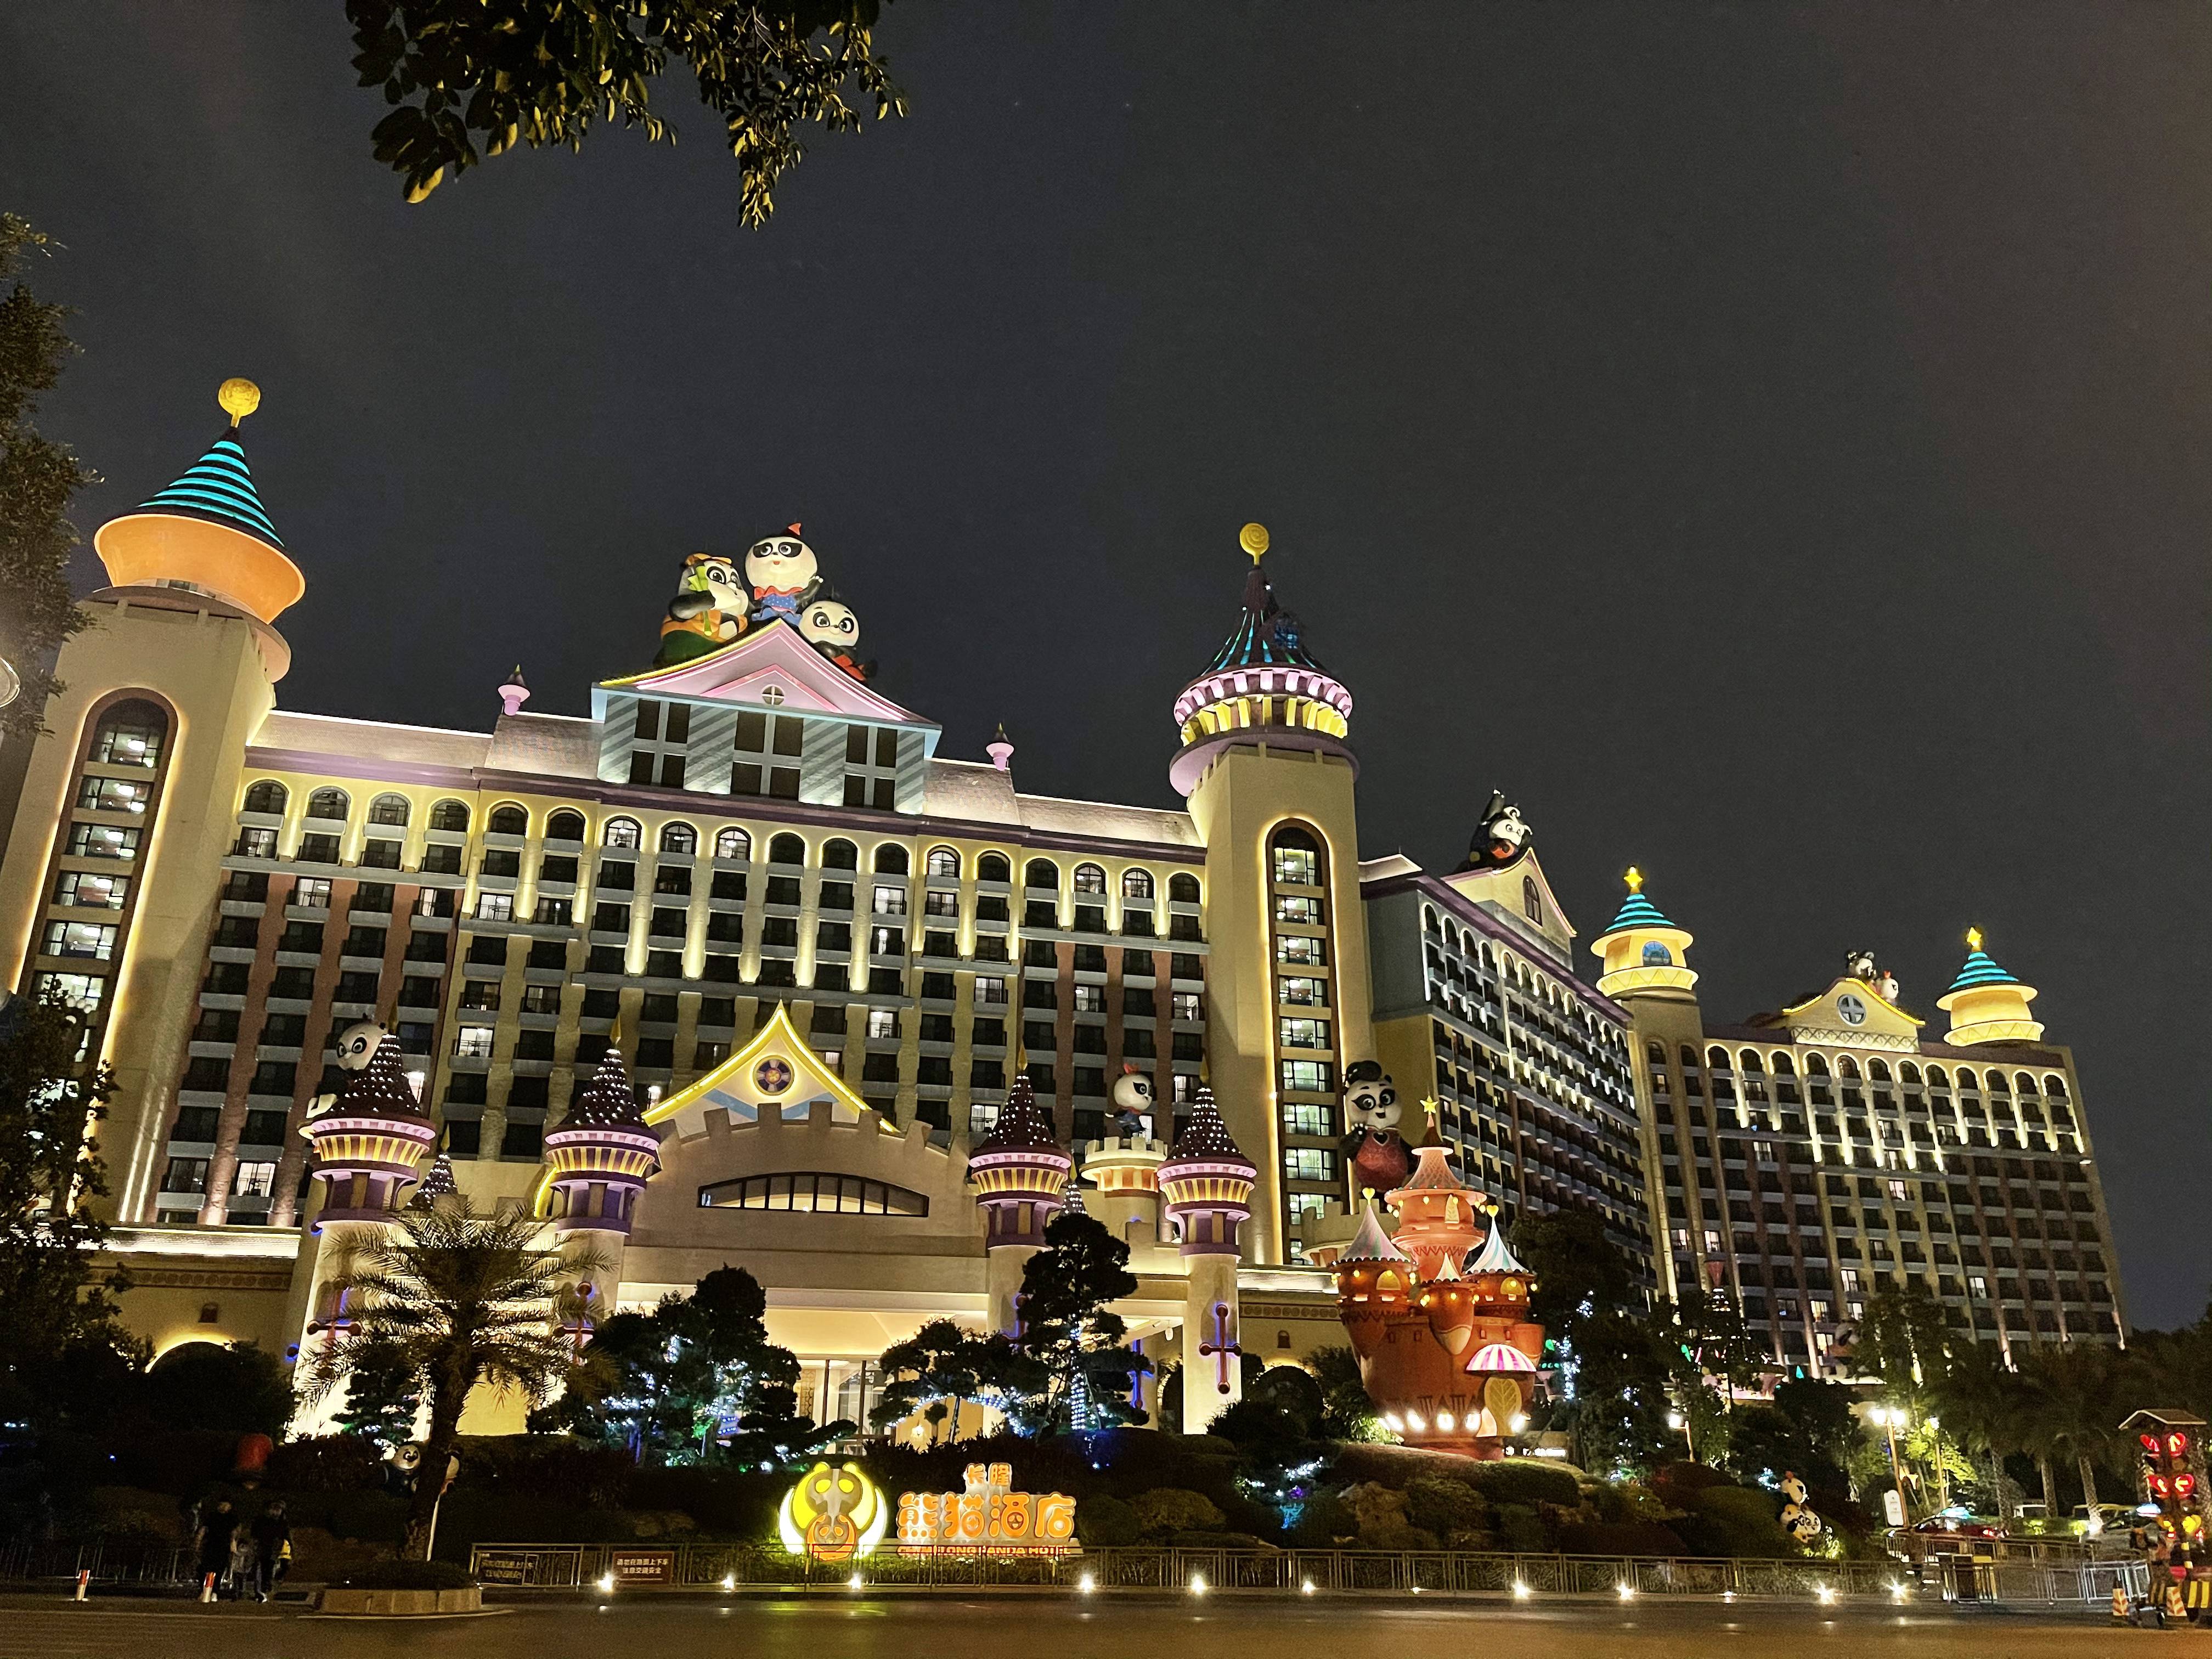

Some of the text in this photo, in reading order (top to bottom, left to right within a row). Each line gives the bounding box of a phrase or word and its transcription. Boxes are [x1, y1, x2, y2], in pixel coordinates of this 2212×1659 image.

[966, 1463, 1012, 1486] 长隆
[898, 1492, 1075, 1539] 熊猫酒店
